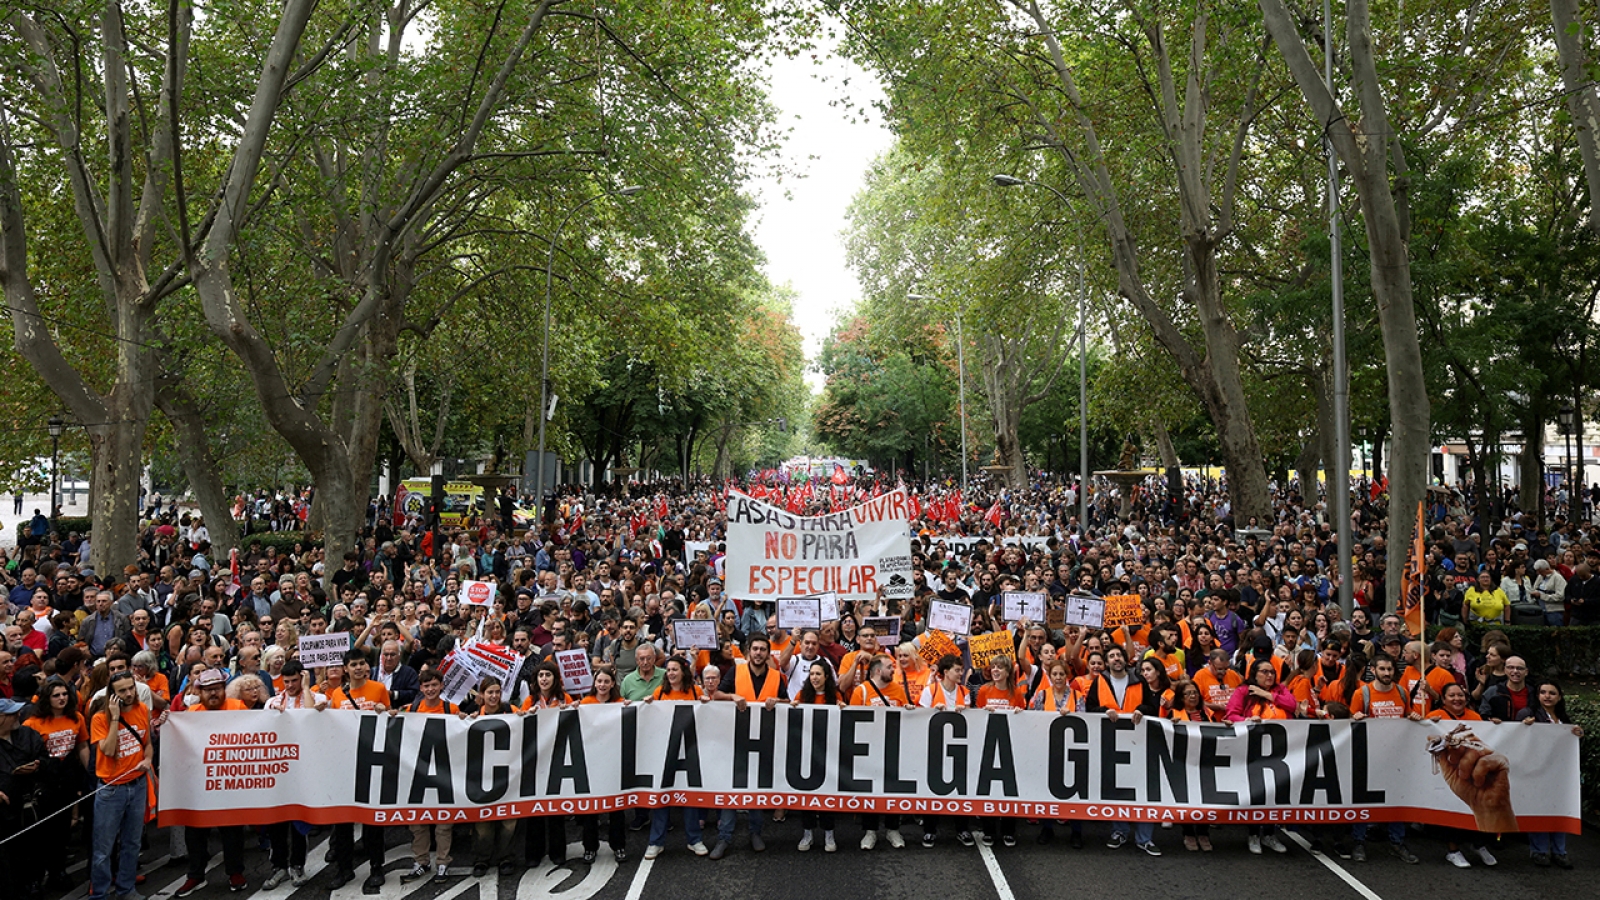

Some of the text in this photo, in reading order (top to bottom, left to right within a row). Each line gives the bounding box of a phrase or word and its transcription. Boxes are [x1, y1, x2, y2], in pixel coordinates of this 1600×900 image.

[801, 511, 855, 531] PARA
[854, 491, 908, 525] VIVIR
[765, 531, 859, 560] NO PARA
[749, 564, 879, 595] ESPECULAR
[559, 653, 586, 662] POR UNA
[563, 661, 586, 670] HUELGA
[564, 668, 590, 678] GENERAL
[209, 732, 278, 745] SINDICATO
[207, 745, 298, 761] DE INQUILINAS
[354, 705, 1386, 806] HACIA LA HUELGA GENERAL
[206, 762, 289, 777] E INQUILINOS
[205, 777, 276, 791] DE MADRID
[374, 808, 468, 823] BAJADA
[479, 805, 521, 820] DEL
[531, 795, 639, 815] ALQUILER
[648, 792, 688, 806] 50%
[714, 794, 876, 811] EXPROPIACIÓN
[886, 799, 973, 813] FONDOS
[983, 802, 1060, 816] BUITRE
[1086, 805, 1218, 821] CONTRATOS
[1228, 809, 1371, 821] INDEFINIDOS
